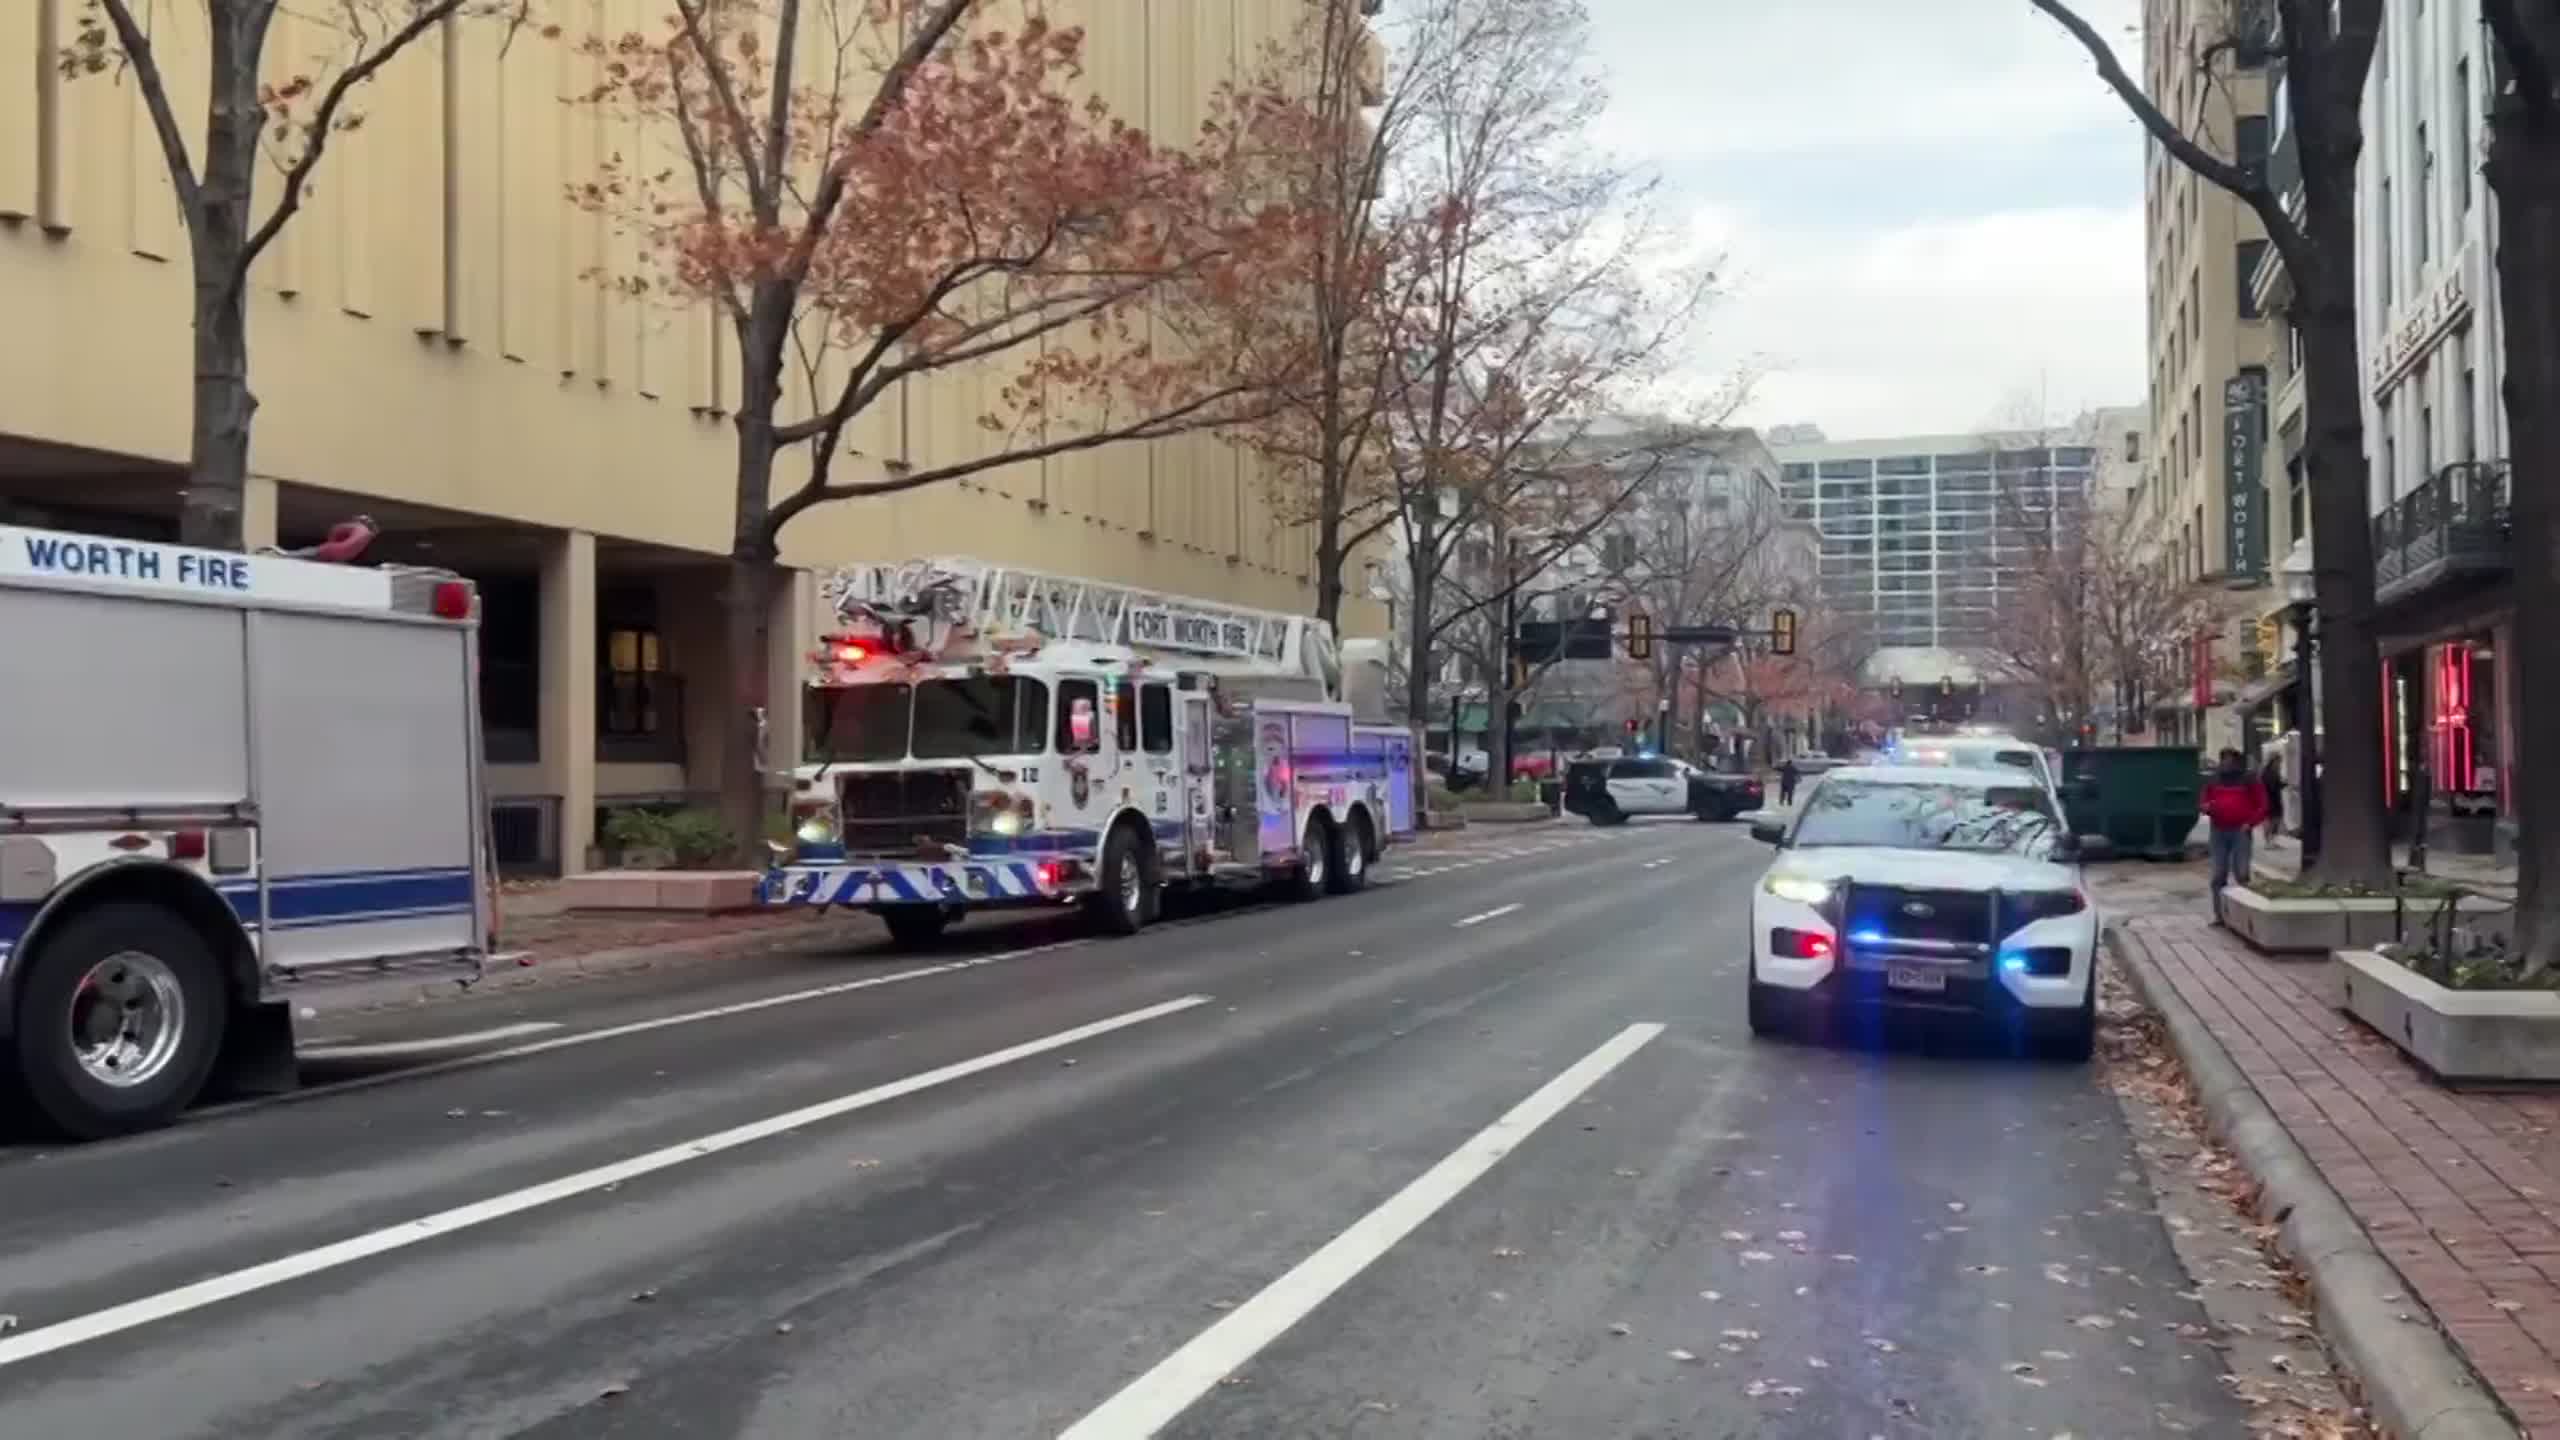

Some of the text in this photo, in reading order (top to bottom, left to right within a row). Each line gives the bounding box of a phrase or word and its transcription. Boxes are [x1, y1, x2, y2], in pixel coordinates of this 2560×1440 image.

[25, 536, 250, 591] WORTH FIRE
[1133, 609, 1169, 640] FORT
